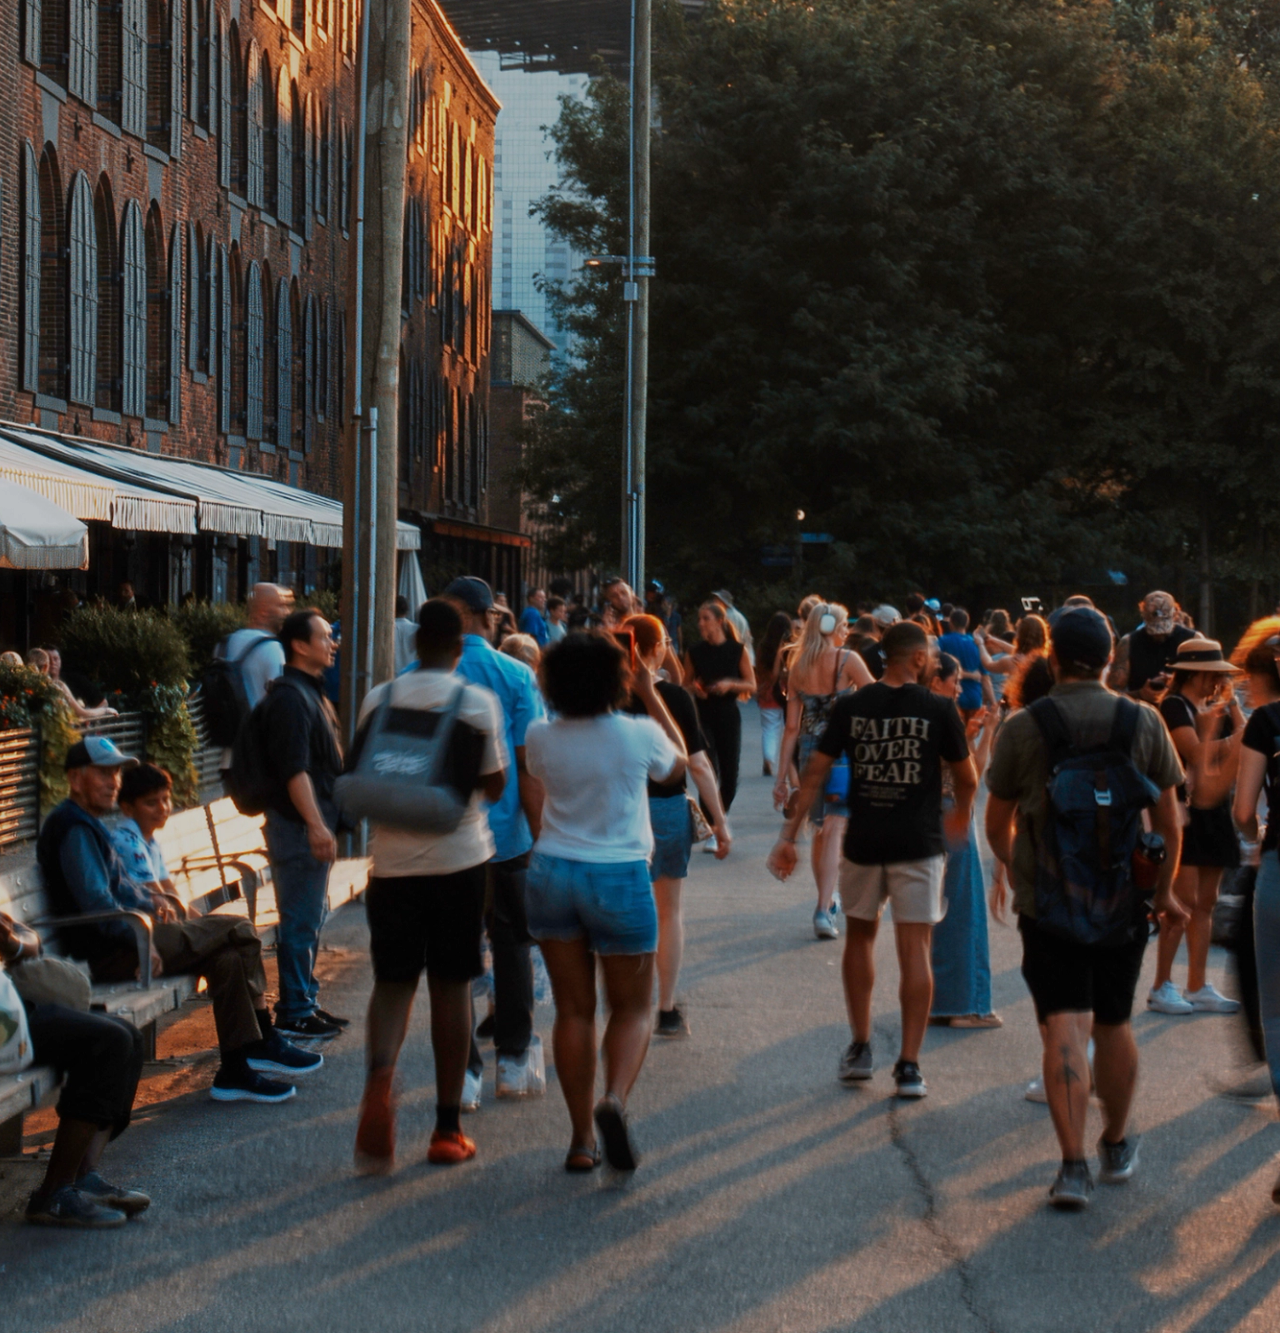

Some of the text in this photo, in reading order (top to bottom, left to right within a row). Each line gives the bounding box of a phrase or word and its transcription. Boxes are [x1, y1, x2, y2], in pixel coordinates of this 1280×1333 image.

[850, 716, 930, 742] FAITH
[855, 738, 921, 761] OVER
[854, 761, 921, 784] FEAR
